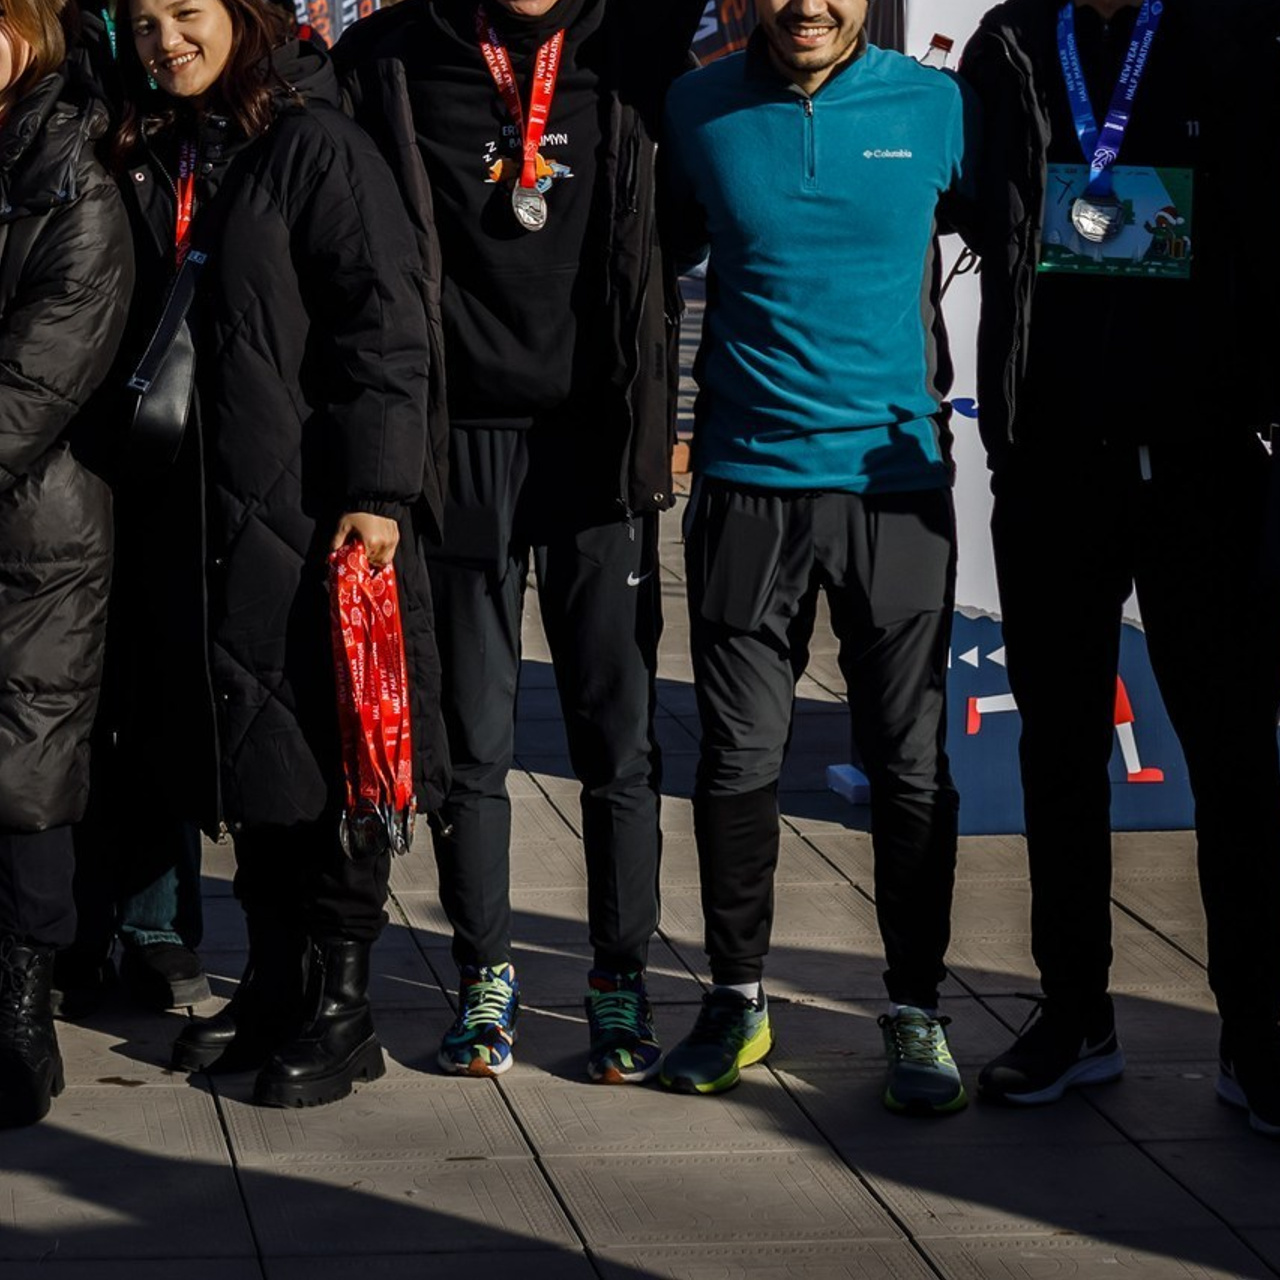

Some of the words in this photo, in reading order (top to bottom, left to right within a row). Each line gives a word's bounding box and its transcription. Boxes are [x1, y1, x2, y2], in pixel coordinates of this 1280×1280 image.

[1125, 41, 1140, 62] YEAR
[1120, 64, 1131, 83] NEW
[1125, 78, 1137, 100] HALF
[1133, 30, 1154, 77] MARATHON
